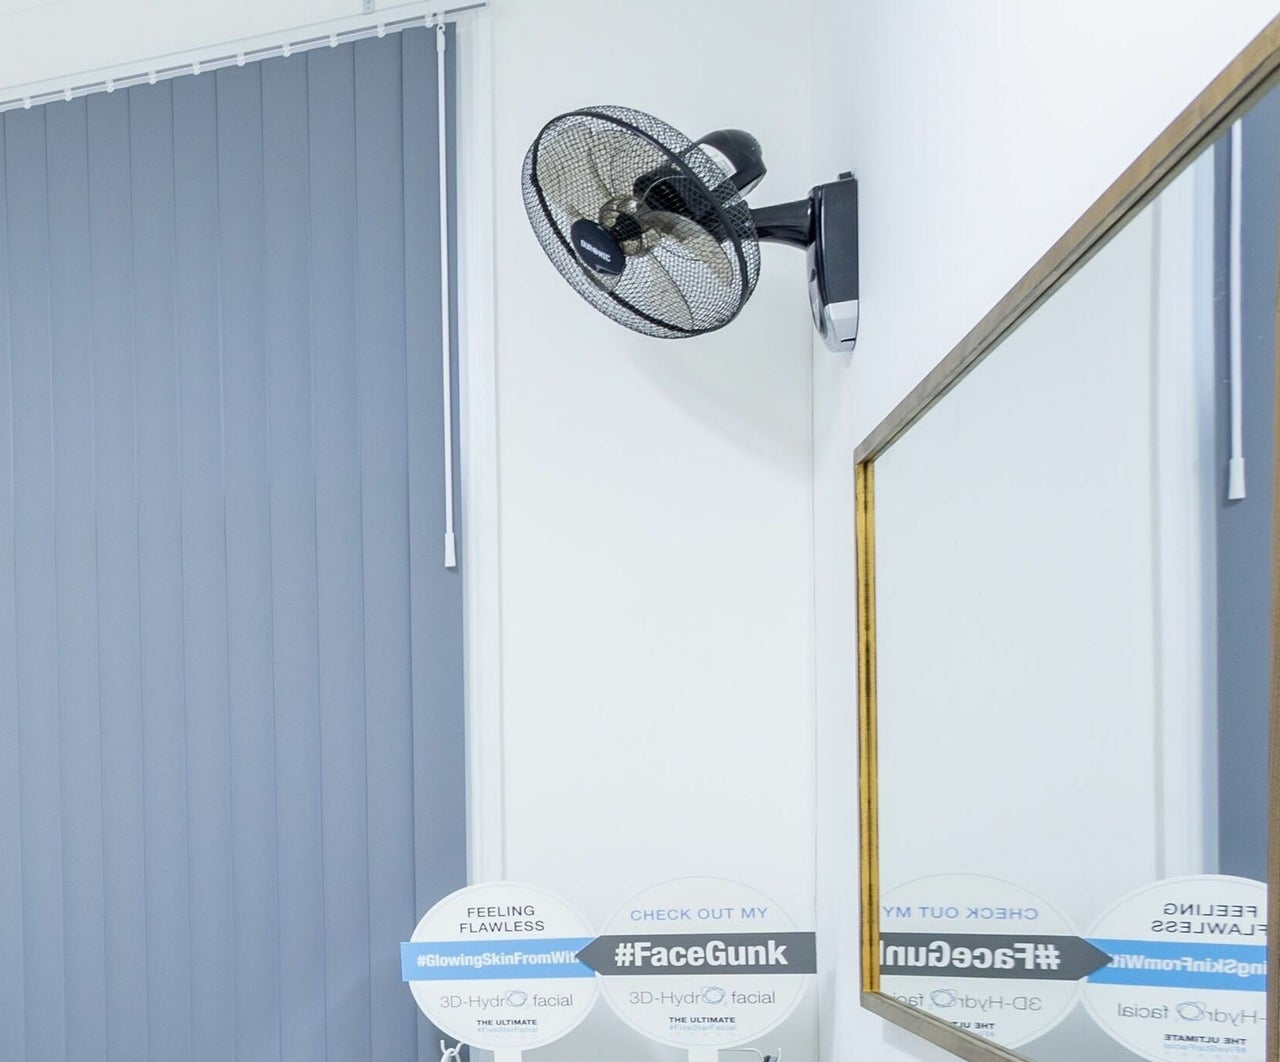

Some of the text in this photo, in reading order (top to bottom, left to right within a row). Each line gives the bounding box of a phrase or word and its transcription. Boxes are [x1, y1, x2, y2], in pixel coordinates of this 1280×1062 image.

[467, 905, 536, 918] FEELING
[630, 907, 768, 921] CHECK OUT MY
[460, 920, 546, 933] FLAWLESS
[614, 940, 789, 967] #FaceGunk
[533, 994, 574, 1008] facial
[731, 991, 776, 1005] facial
[669, 1016, 737, 1024] THE ULTIMATE
